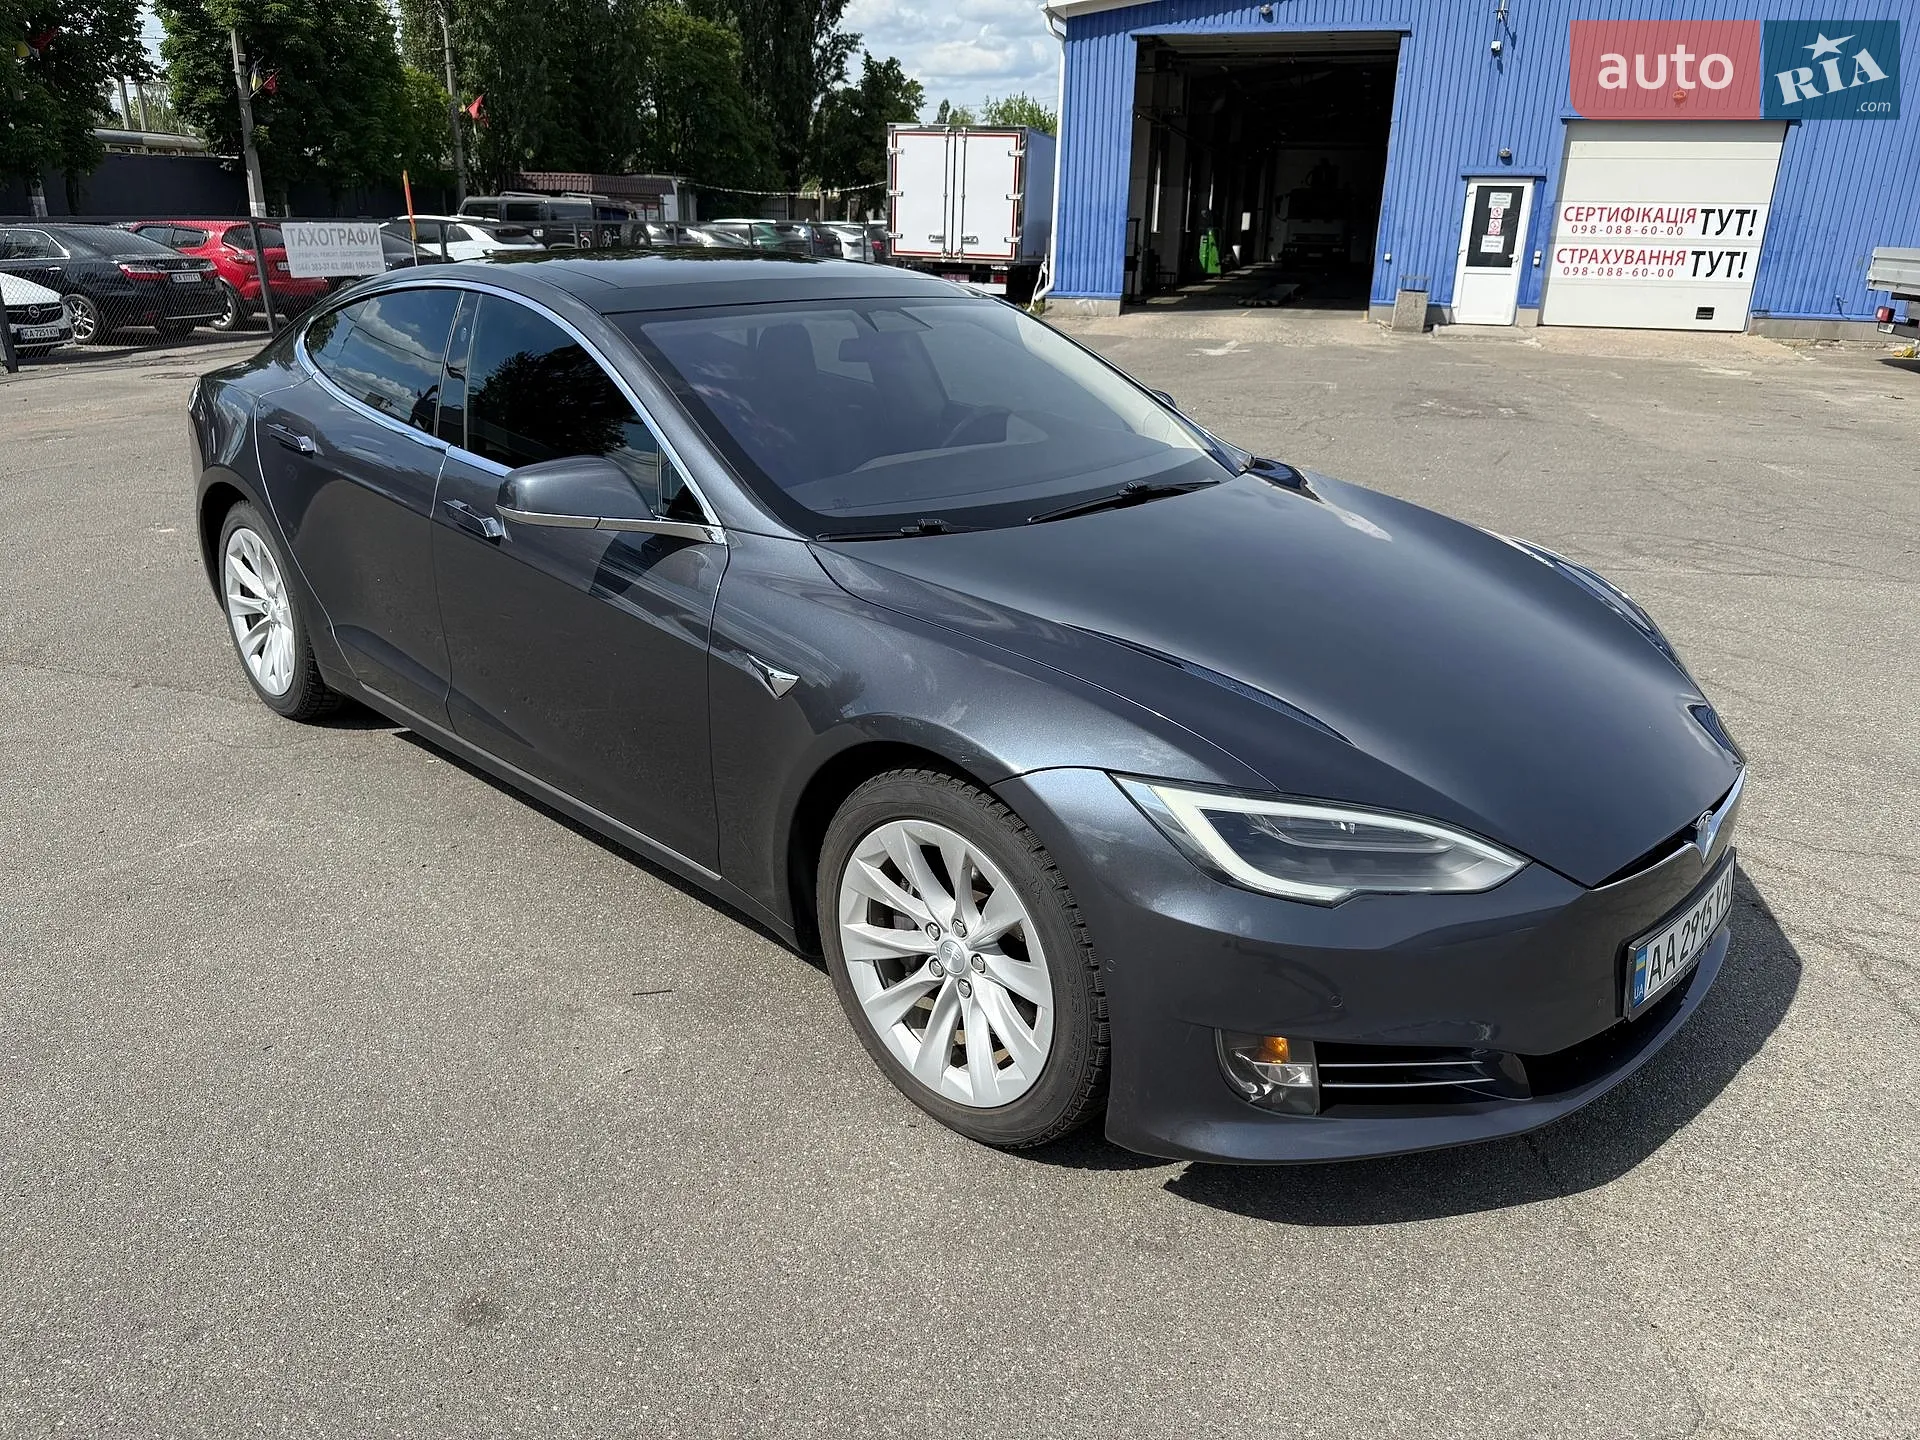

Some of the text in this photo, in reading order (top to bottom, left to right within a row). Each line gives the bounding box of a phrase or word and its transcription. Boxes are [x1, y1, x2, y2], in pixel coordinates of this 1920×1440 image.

[1564, 206, 1758, 237] СЕРТИФІКАЦІЯ ТУТ!
[1571, 225, 1685, 236] 098-088-60-00
[286, 227, 380, 246] ТАХОГРАФИ
[1556, 248, 1748, 279] СТРАХУВАННЯ ТУТ!
[1563, 267, 1675, 279] 098-088-60-00
[1647, 932, 1676, 990] AA
[1680, 891, 1714, 963] 2915
[1634, 985, 1645, 998] UA
